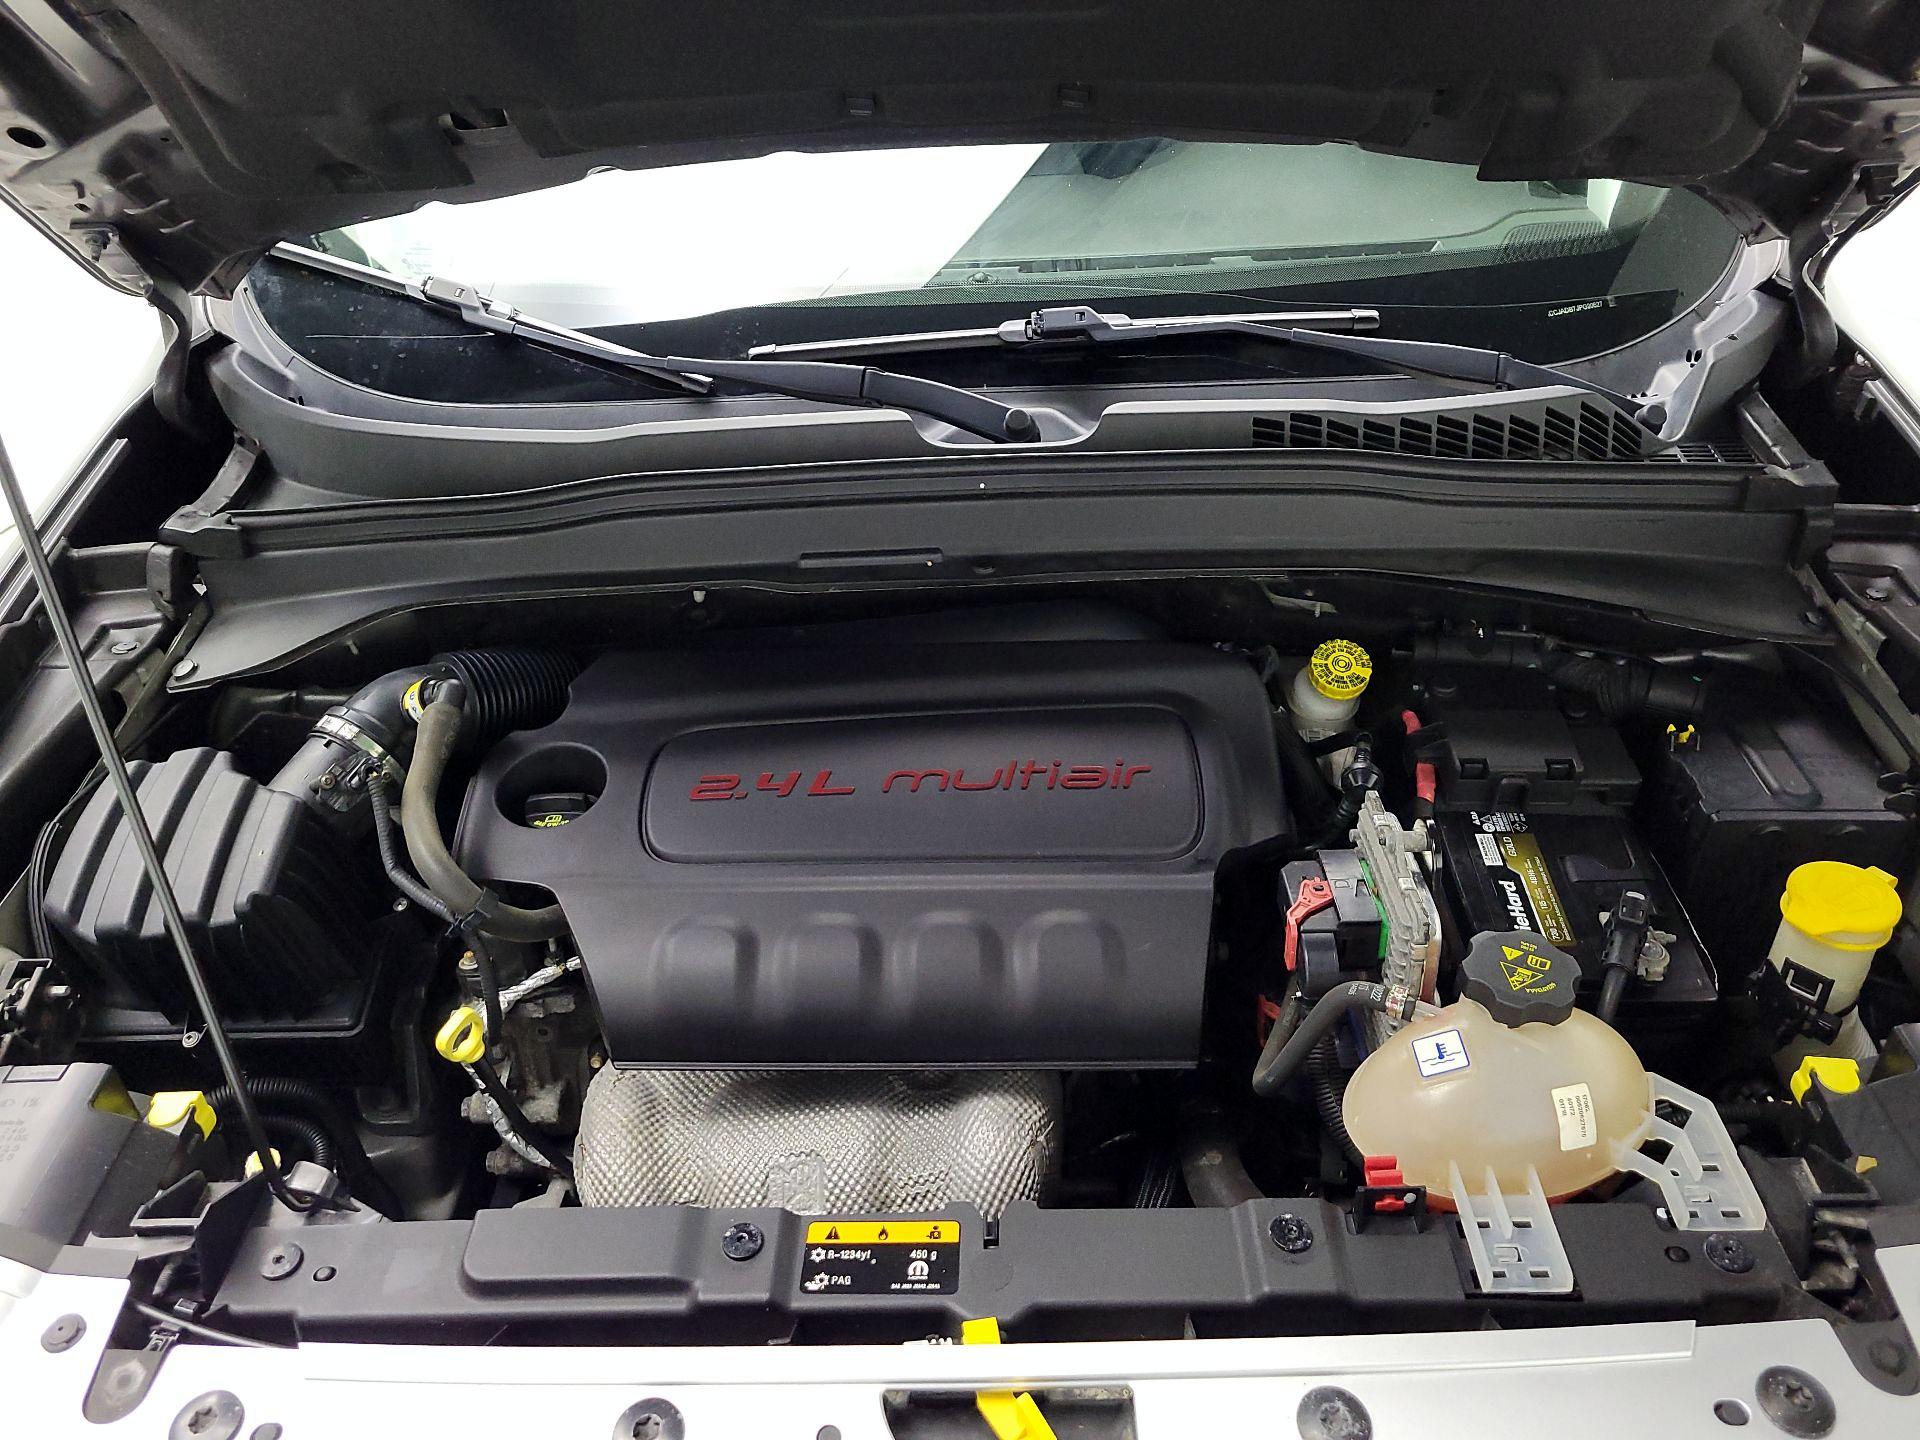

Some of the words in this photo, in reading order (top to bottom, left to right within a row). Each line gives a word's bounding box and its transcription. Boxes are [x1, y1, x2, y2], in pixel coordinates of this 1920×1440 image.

[882, 757, 1152, 793] multiair
[1503, 836, 1517, 857] GOLD
[1498, 880, 1531, 930] ieHard
[827, 1249, 871, 1261] R-1234yf
[909, 1249, 927, 1259] 450
[930, 1251, 938, 1261] g
[830, 1275, 851, 1285] PAG
